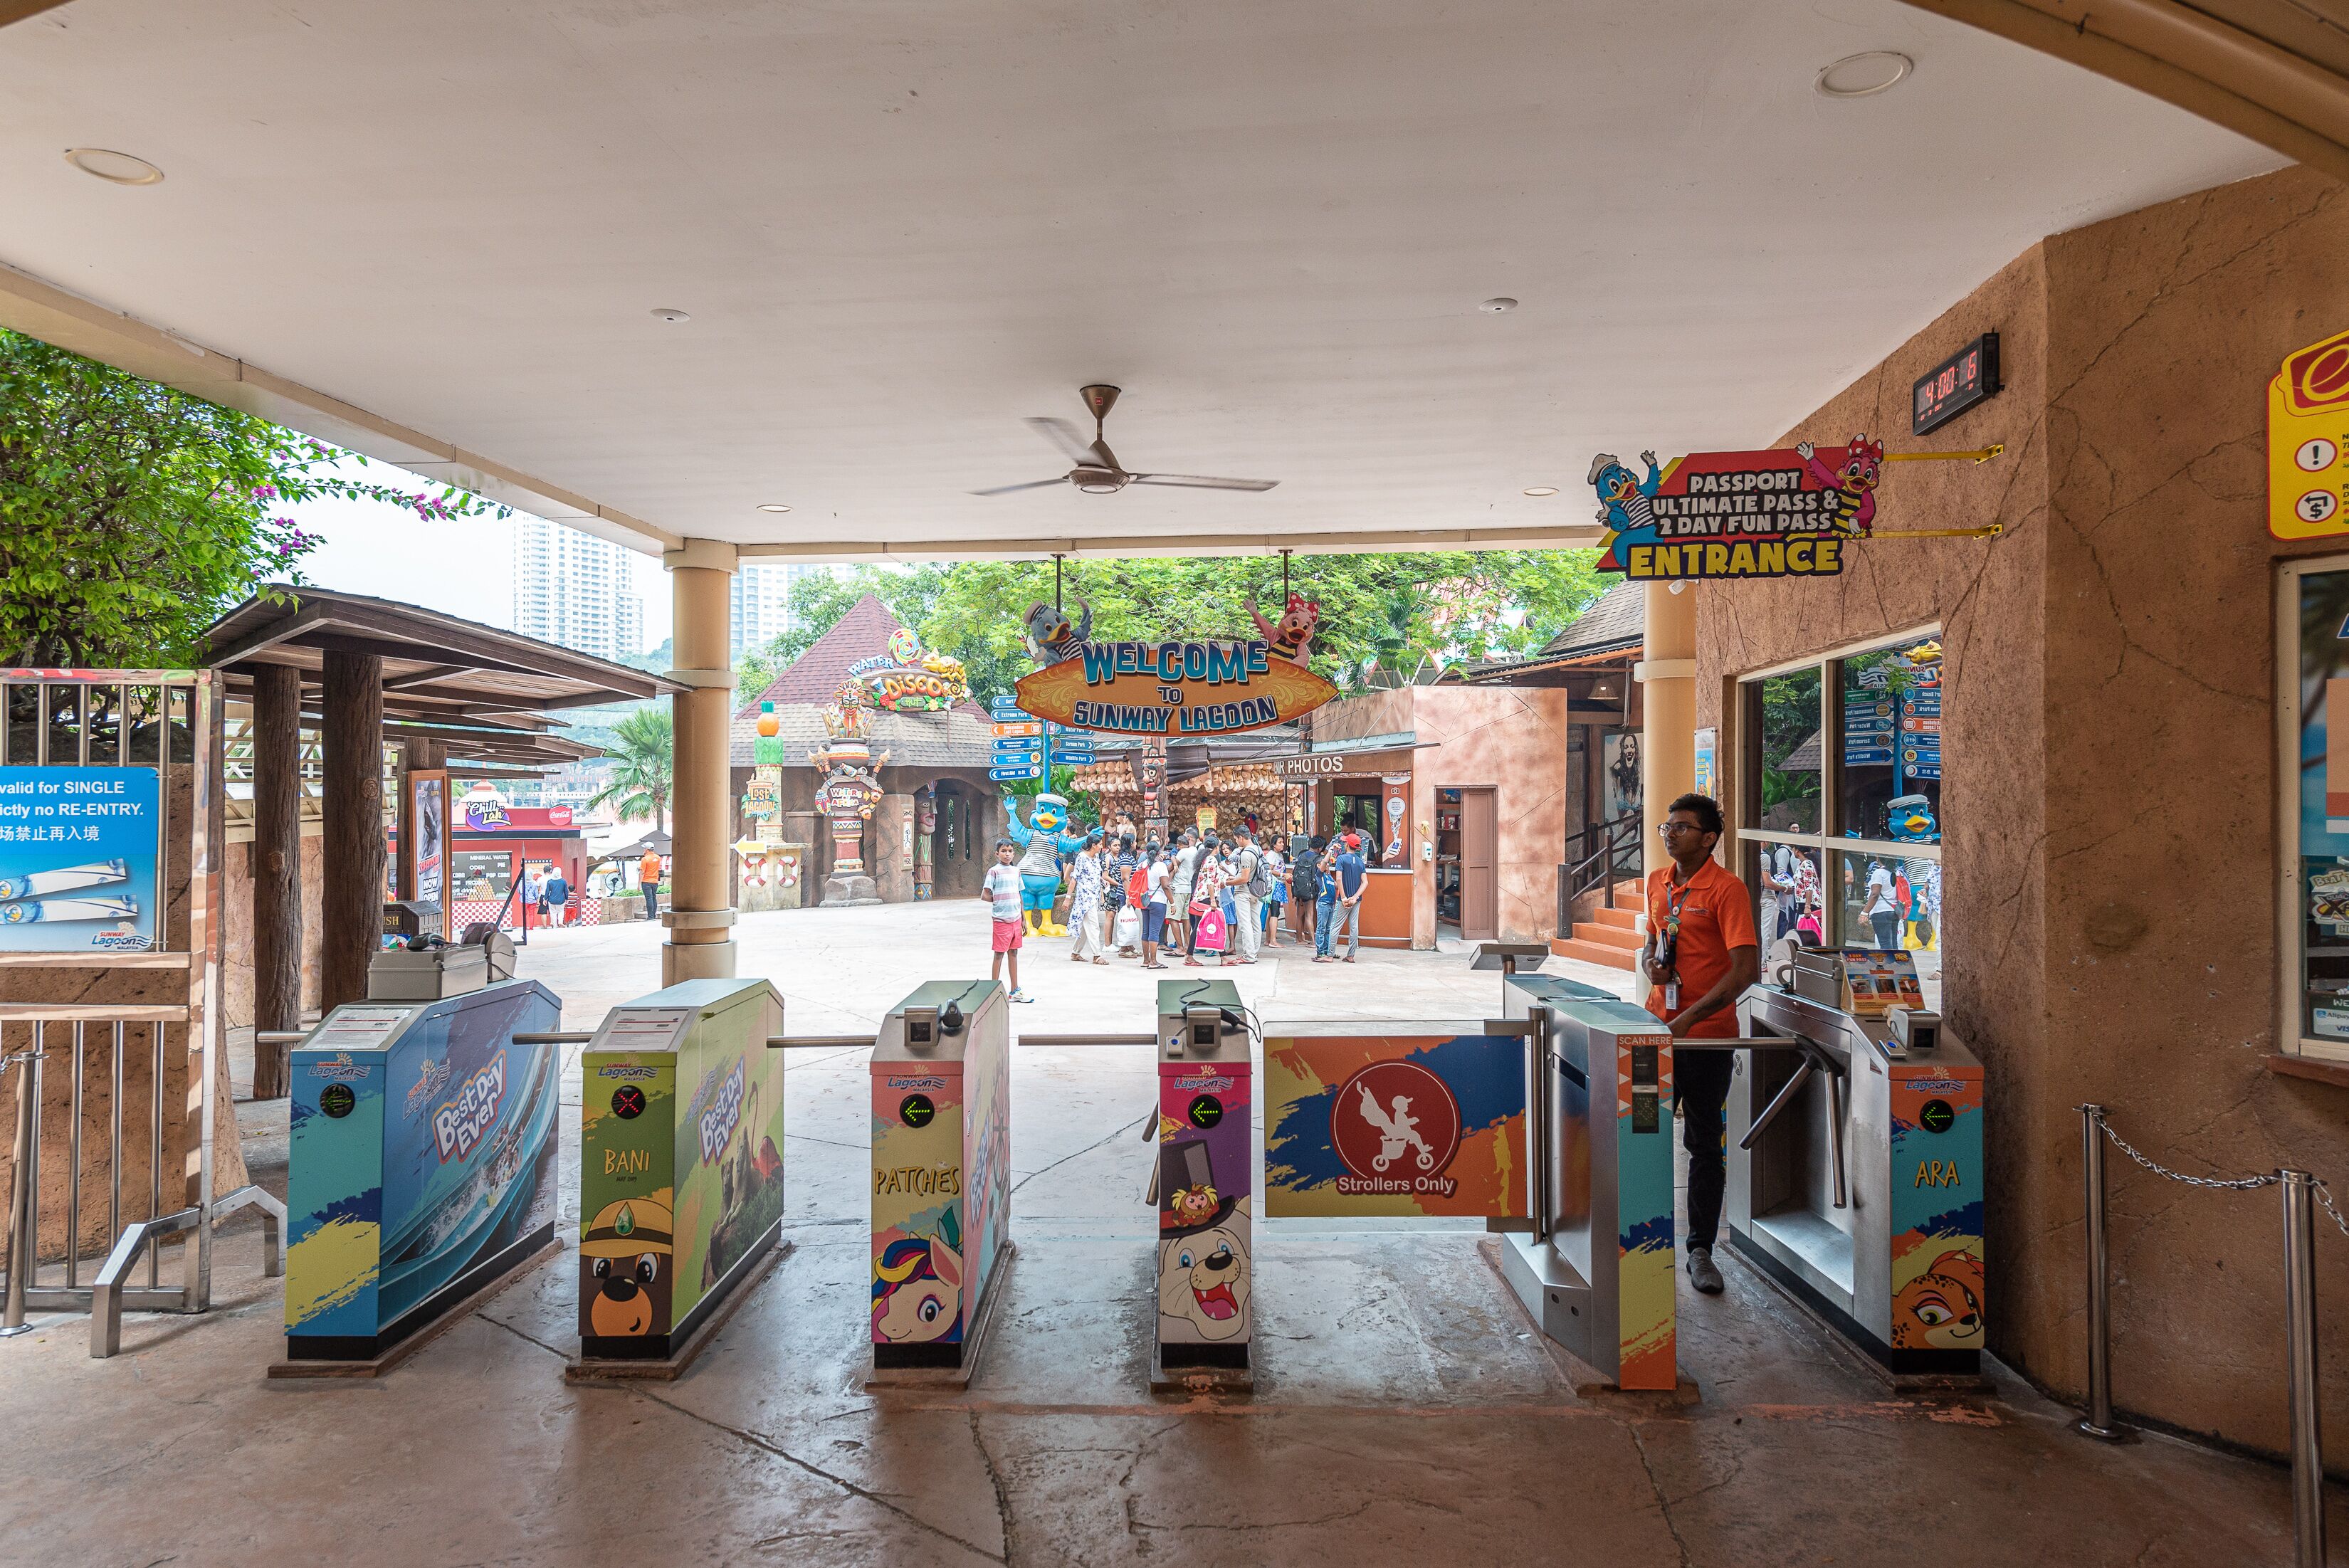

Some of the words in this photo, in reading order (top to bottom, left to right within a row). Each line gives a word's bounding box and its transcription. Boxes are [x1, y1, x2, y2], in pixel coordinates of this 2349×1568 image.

[1691, 472, 1799, 493] PASSPORT
[1653, 495, 1758, 515] ULTIMATE
[1764, 493, 1816, 512] PASS
[1824, 491, 1838, 507] &
[1660, 518, 1671, 535] 2
[1678, 516, 1722, 535] DAY
[1728, 515, 1771, 532] FUN
[1777, 512, 1831, 530] PASS
[1629, 540, 1839, 577] ENTRANCE
[848, 654, 895, 676] WATER
[1080, 639, 1270, 684] WELCOME
[1157, 685, 1182, 704] TO
[1073, 700, 1172, 732] SUNWAY
[1179, 695, 1277, 732] LAGOON
[1288, 756, 1343, 774] PHOTOS
[0, 782, 33, 794] valid
[38, 782, 60, 794] for
[63, 781, 125, 794] SINGLE
[35, 806, 54, 816] no
[59, 803, 144, 816] RE-ENTRY.
[423, 877, 438, 890] NOW
[91, 936, 136, 947] Lagoon
[1619, 1036, 1646, 1045] SCAN
[1649, 1036, 1671, 1045] HERE
[309, 1065, 354, 1078] Lagoon
[599, 1067, 643, 1079] Lagoon
[888, 1077, 931, 1090] Lagoon
[1174, 1078, 1218, 1090] Lagoon
[1906, 1080, 1950, 1092] Lagoon
[436, 1088, 477, 1157] Best
[700, 1090, 727, 1161] Best
[604, 1148, 650, 1175] BANI
[874, 1166, 960, 1196] PATCHES
[1915, 1159, 1960, 1188] ARA
[1338, 1176, 1410, 1192] Strollers
[1415, 1176, 1454, 1195] Only
